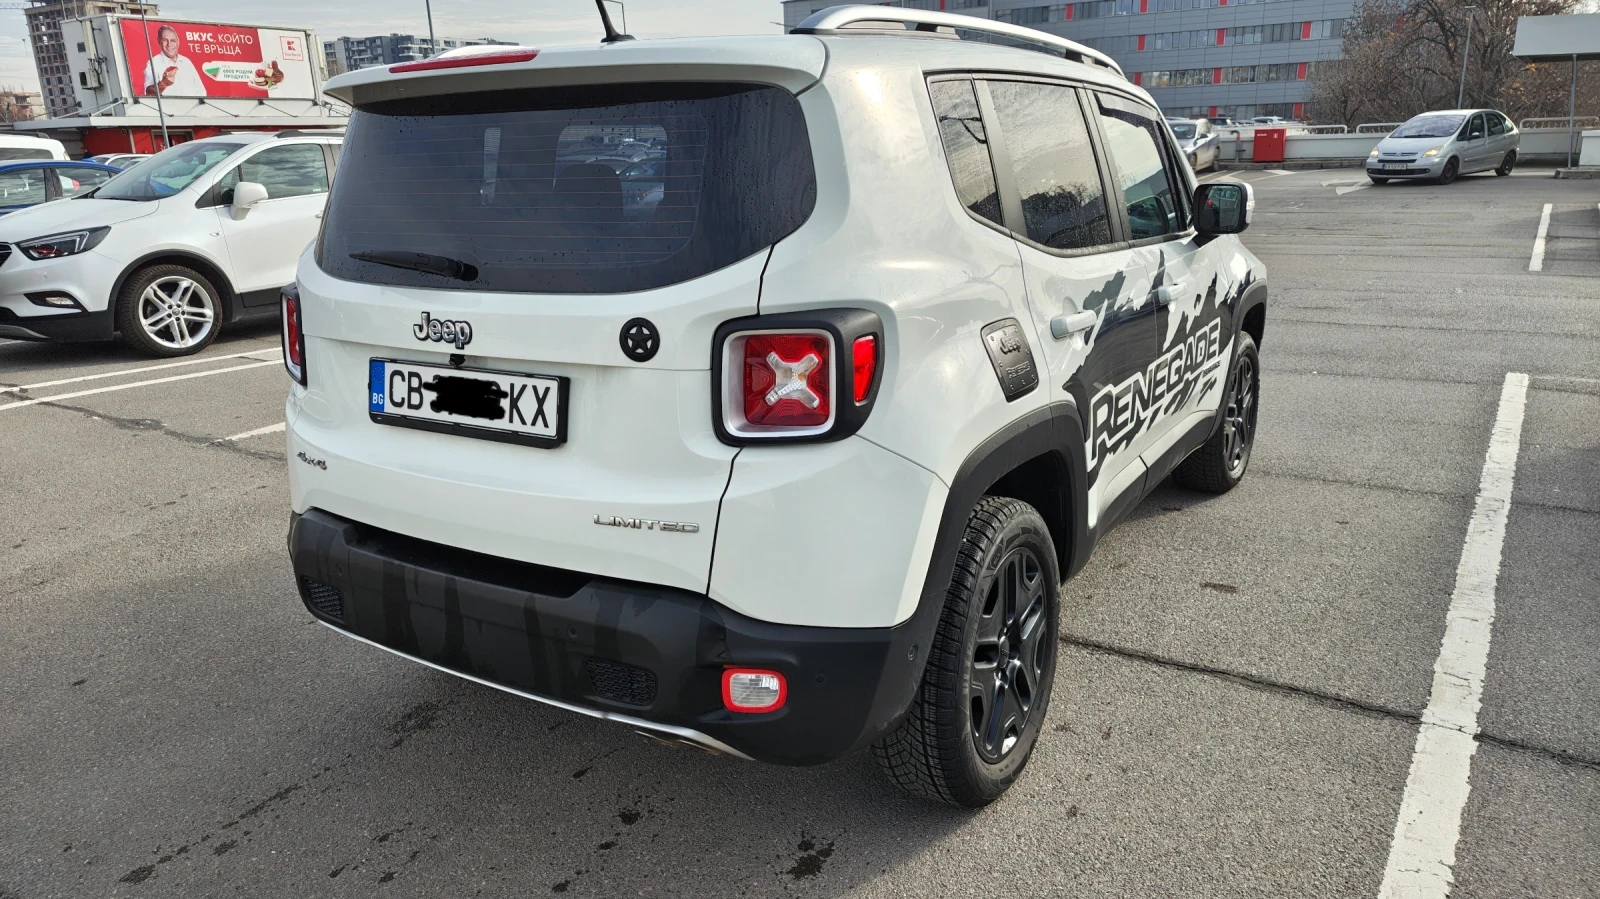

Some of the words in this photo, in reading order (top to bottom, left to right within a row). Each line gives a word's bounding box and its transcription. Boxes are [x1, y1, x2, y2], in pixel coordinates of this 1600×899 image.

[186, 31, 216, 43] ВКУС,
[217, 33, 253, 45] КОЙТО
[188, 43, 202, 53] ТЕ
[204, 44, 242, 56] ВРЪЩА
[412, 311, 473, 350] Jeep
[372, 392, 384, 405] BG
[389, 369, 424, 410] CB
[508, 382, 551, 428] KX
[1089, 317, 1221, 466] RENEGADE
[593, 513, 699, 533] LIMITED
